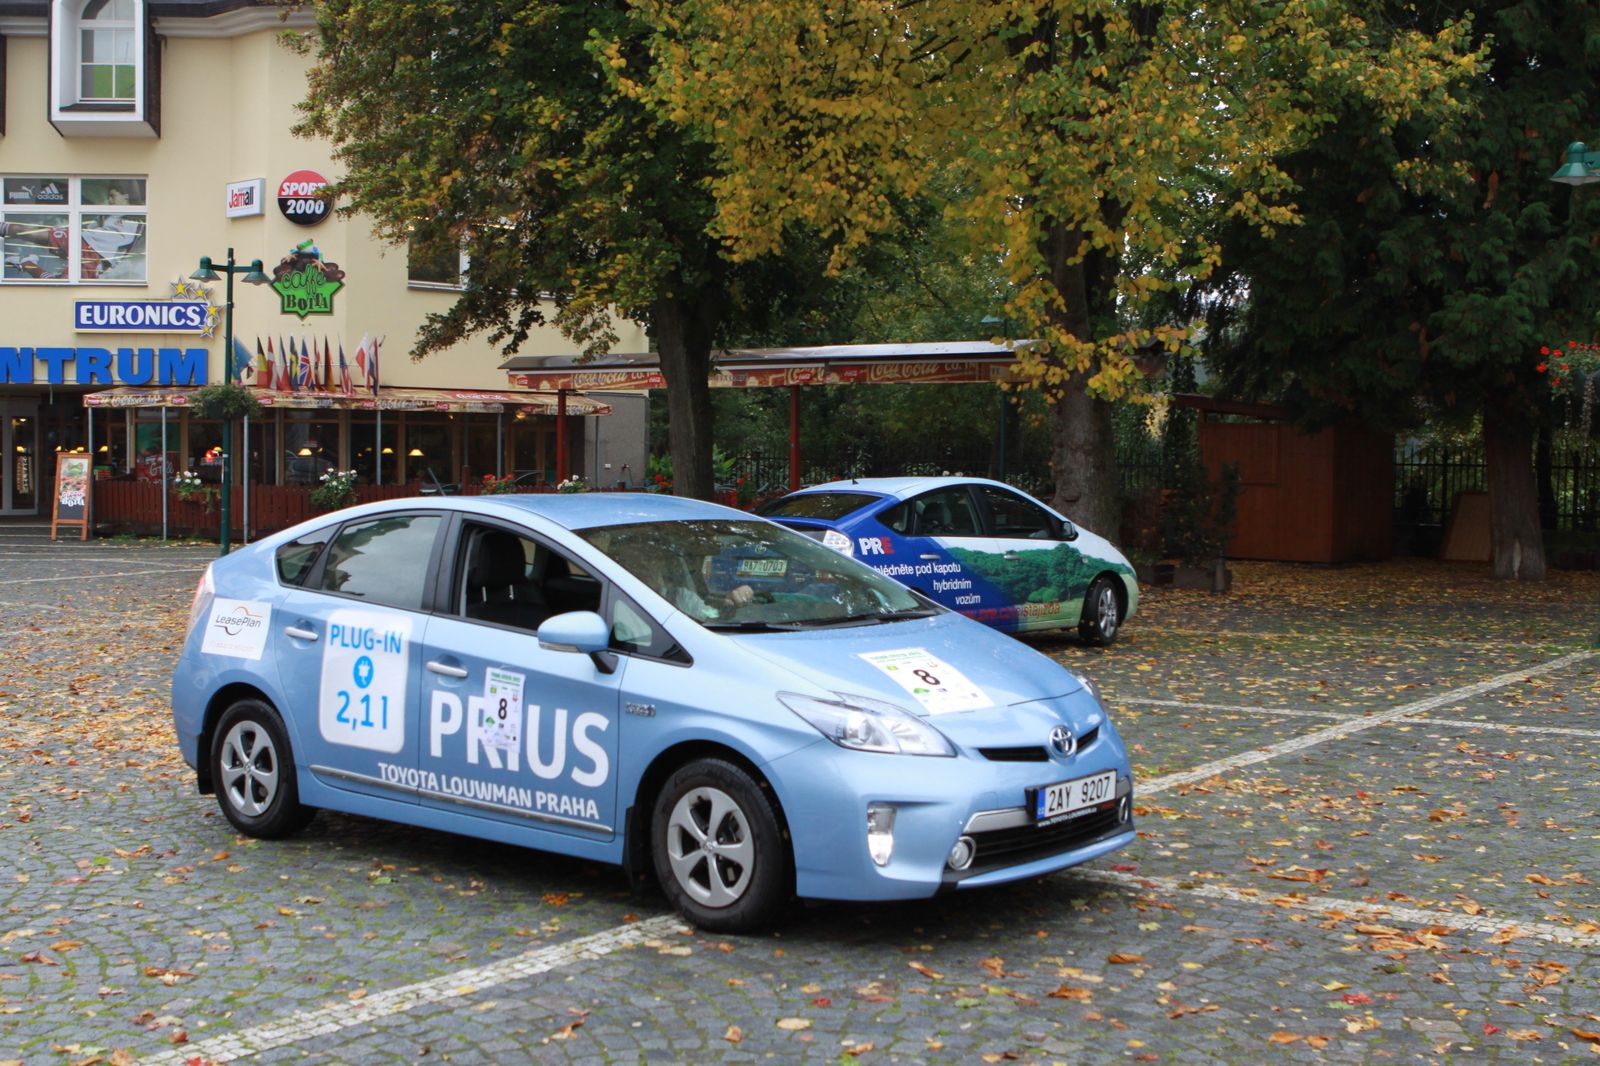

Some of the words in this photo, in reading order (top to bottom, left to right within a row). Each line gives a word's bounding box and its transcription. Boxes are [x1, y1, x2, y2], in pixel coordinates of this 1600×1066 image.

[37, 192, 65, 200] adidas
[229, 186, 254, 208] Jamall
[286, 199, 325, 214] 2000
[80, 305, 201, 326] EURONICS
[0, 347, 209, 385] NTRUM
[858, 536, 895, 555] PRE
[915, 562, 932, 577] pod
[933, 561, 962, 576] kapotu
[933, 579, 972, 591] hybridním
[955, 594, 981, 606] vozům
[215, 614, 262, 629] LeasePlan
[329, 624, 403, 655] PLUG-IN
[912, 668, 941, 686] 8
[498, 698, 508, 720] 8
[377, 762, 439, 792] TOYOTA
[441, 774, 533, 809] LOUWMAN
[535, 791, 600, 820] PRAHA
[1047, 785, 1072, 813] 2AY
[1081, 776, 1111, 804] 9207
